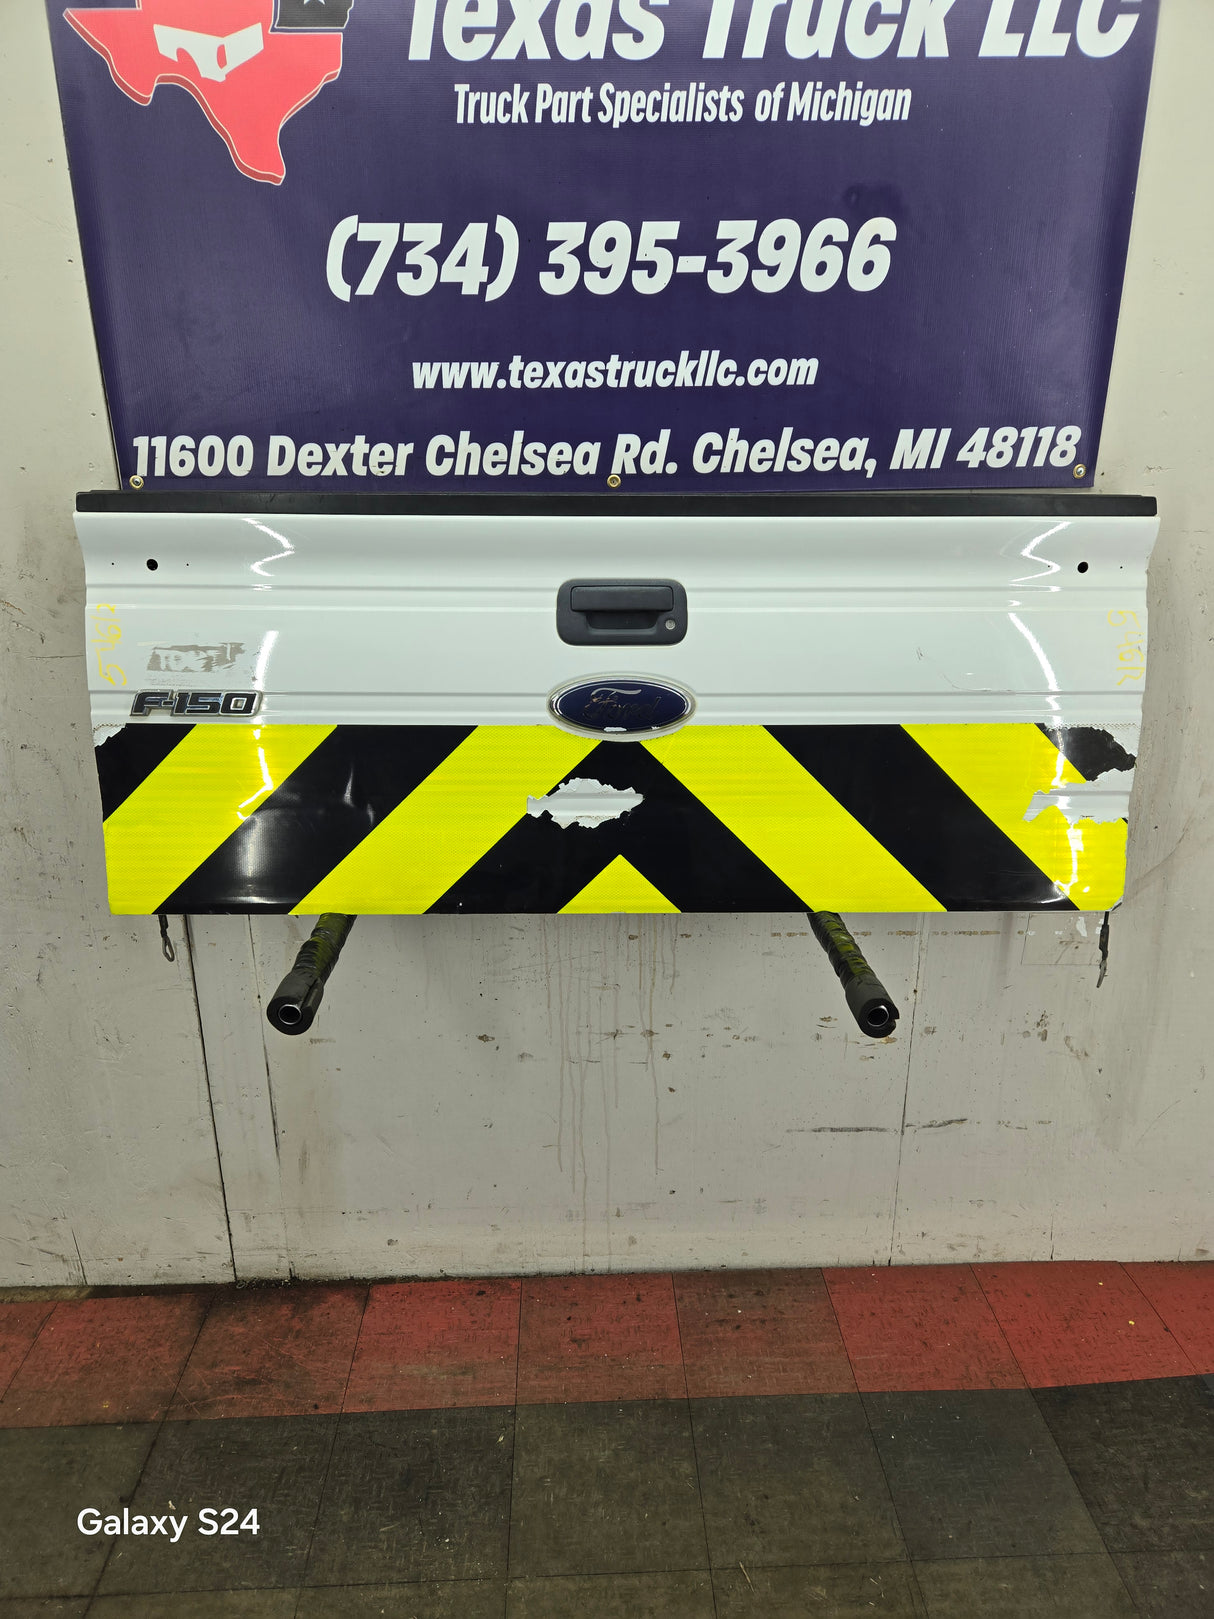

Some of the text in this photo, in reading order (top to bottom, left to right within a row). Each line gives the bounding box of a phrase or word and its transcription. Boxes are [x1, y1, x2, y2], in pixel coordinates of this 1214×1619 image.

[978, 0, 1142, 58] LLC
[455, 80, 912, 128] Truck Part Specialists of Michigan
[326, 214, 898, 302] (734) 395-3966
[413, 350, 819, 389] www.texastruckllc.com
[132, 425, 1082, 478] 11600 Dexter Chelsea Rd. Chelsea, MI 48118
[131, 689, 263, 717] F-150
